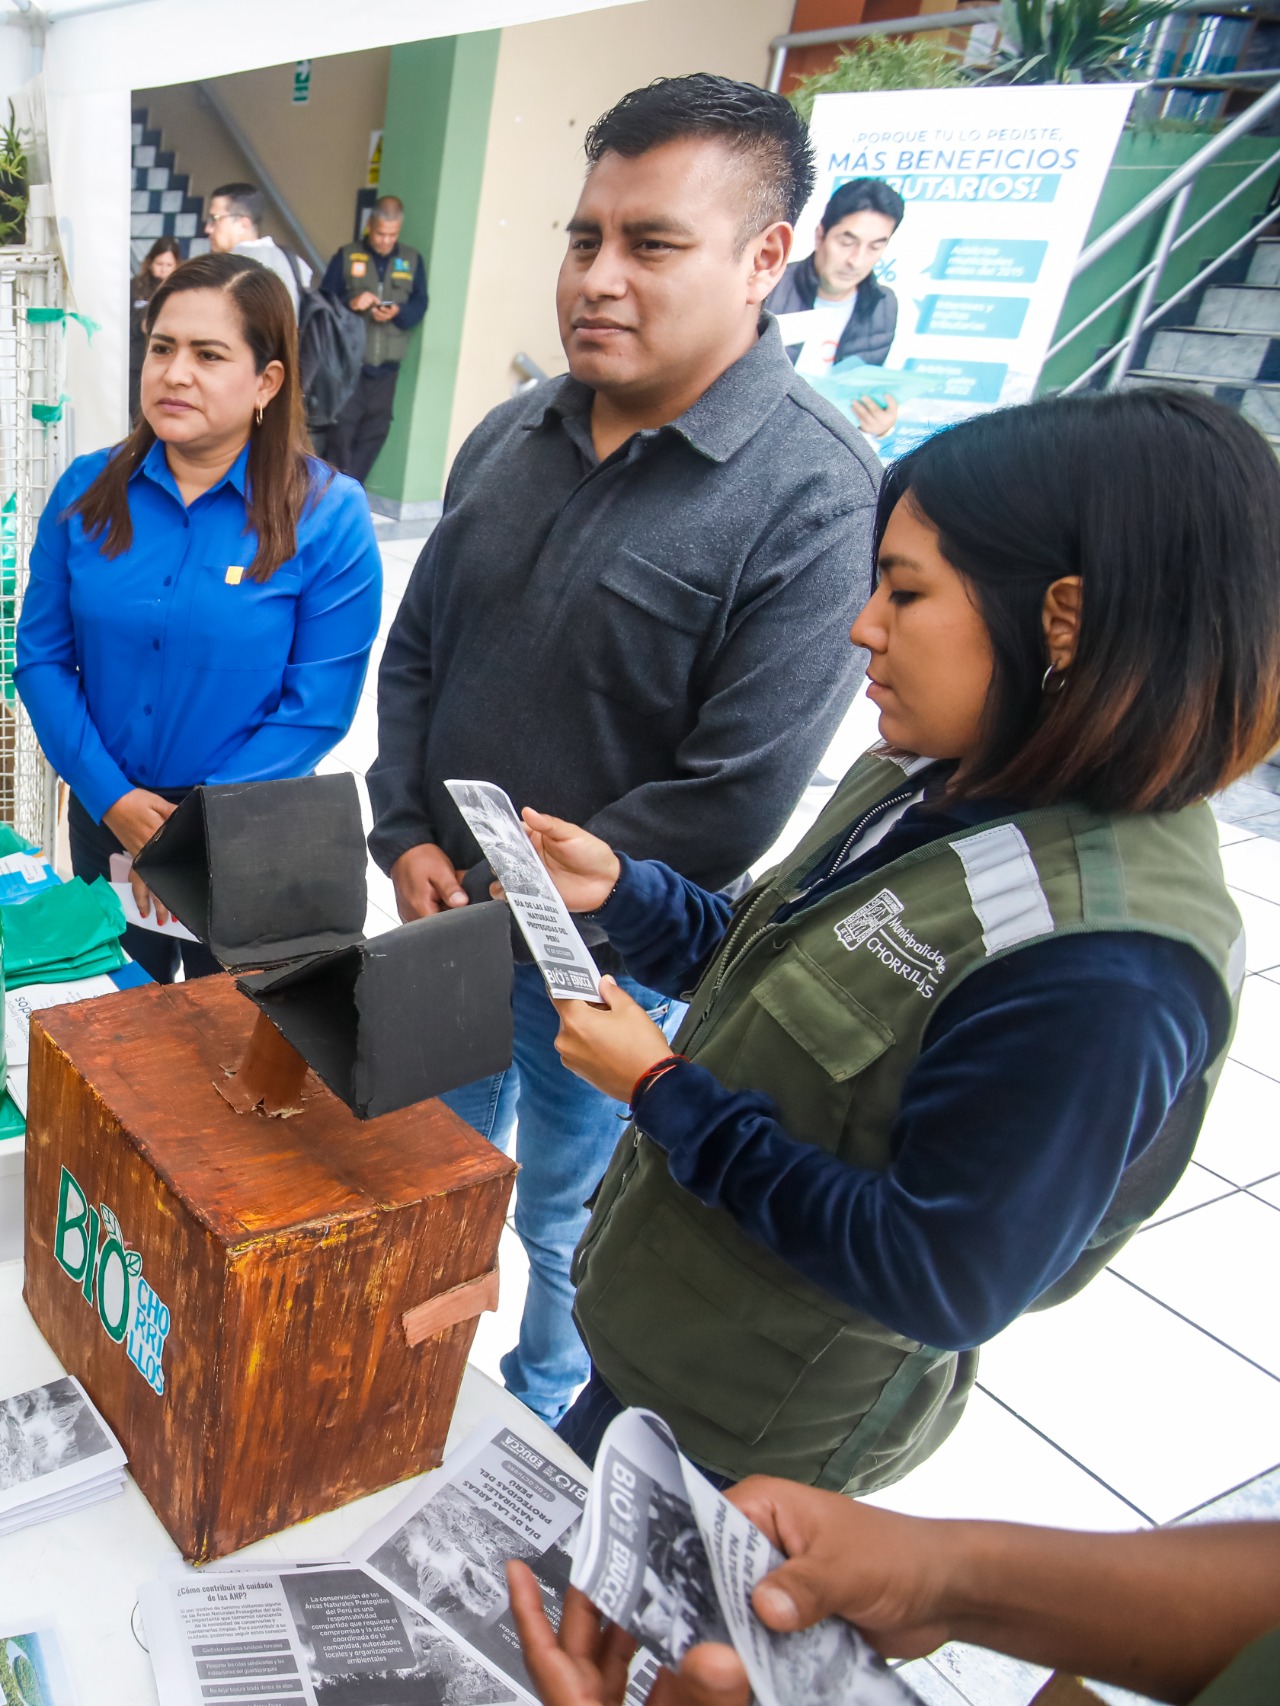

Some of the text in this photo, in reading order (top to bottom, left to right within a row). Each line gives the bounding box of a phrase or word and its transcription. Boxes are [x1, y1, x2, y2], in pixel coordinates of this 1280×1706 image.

[959, 130, 980, 141] LO
[986, 128, 1063, 142] PEDISTE,
[828, 146, 1079, 171] MÁS BENEFICIOS
[569, 974, 593, 988] EDUCCA
[55, 1165, 170, 1344] BIO CHO
[134, 1307, 164, 1359] RRI
[127, 1330, 164, 1394] LLOS
[503, 1435, 544, 1468] EDUCCA
[505, 1462, 534, 1486] OCTUBRE
[507, 1478, 533, 1500] PERÚ
[534, 1484, 543, 1493] DE
[552, 1471, 589, 1503] BIO
[610, 1461, 635, 1519] BIO
[477, 1467, 552, 1525] PROTEGIDAS DEL
[481, 1481, 534, 1522] NATURALES
[461, 1479, 541, 1540] DÍA DE LAS ÁREAS
[176, 1586, 200, 1596] ¿Cómo
[202, 1583, 235, 1594] contribuir
[246, 1580, 273, 1590] cuidado
[217, 1593, 227, 1601] las
[229, 1592, 247, 1600] ANP?
[319, 1593, 360, 1602] conservación
[323, 1599, 354, 1607] Naturales
[355, 1596, 389, 1605] Protegidas
[311, 1621, 348, 1630] compartida
[362, 1617, 390, 1626] requiere
[327, 1612, 376, 1623] responsabilidad
[319, 1627, 359, 1637] compromiso
[373, 1624, 394, 1632] acción
[497, 1622, 521, 1642] egidas
[501, 1632, 511, 1642] las
[322, 1638, 400, 1652] comunidad, autoridades
[332, 1634, 369, 1643] coordinada
[324, 1650, 348, 1658] locales
[353, 1645, 403, 1656] organizaciones
[346, 1655, 387, 1664] ambientales
